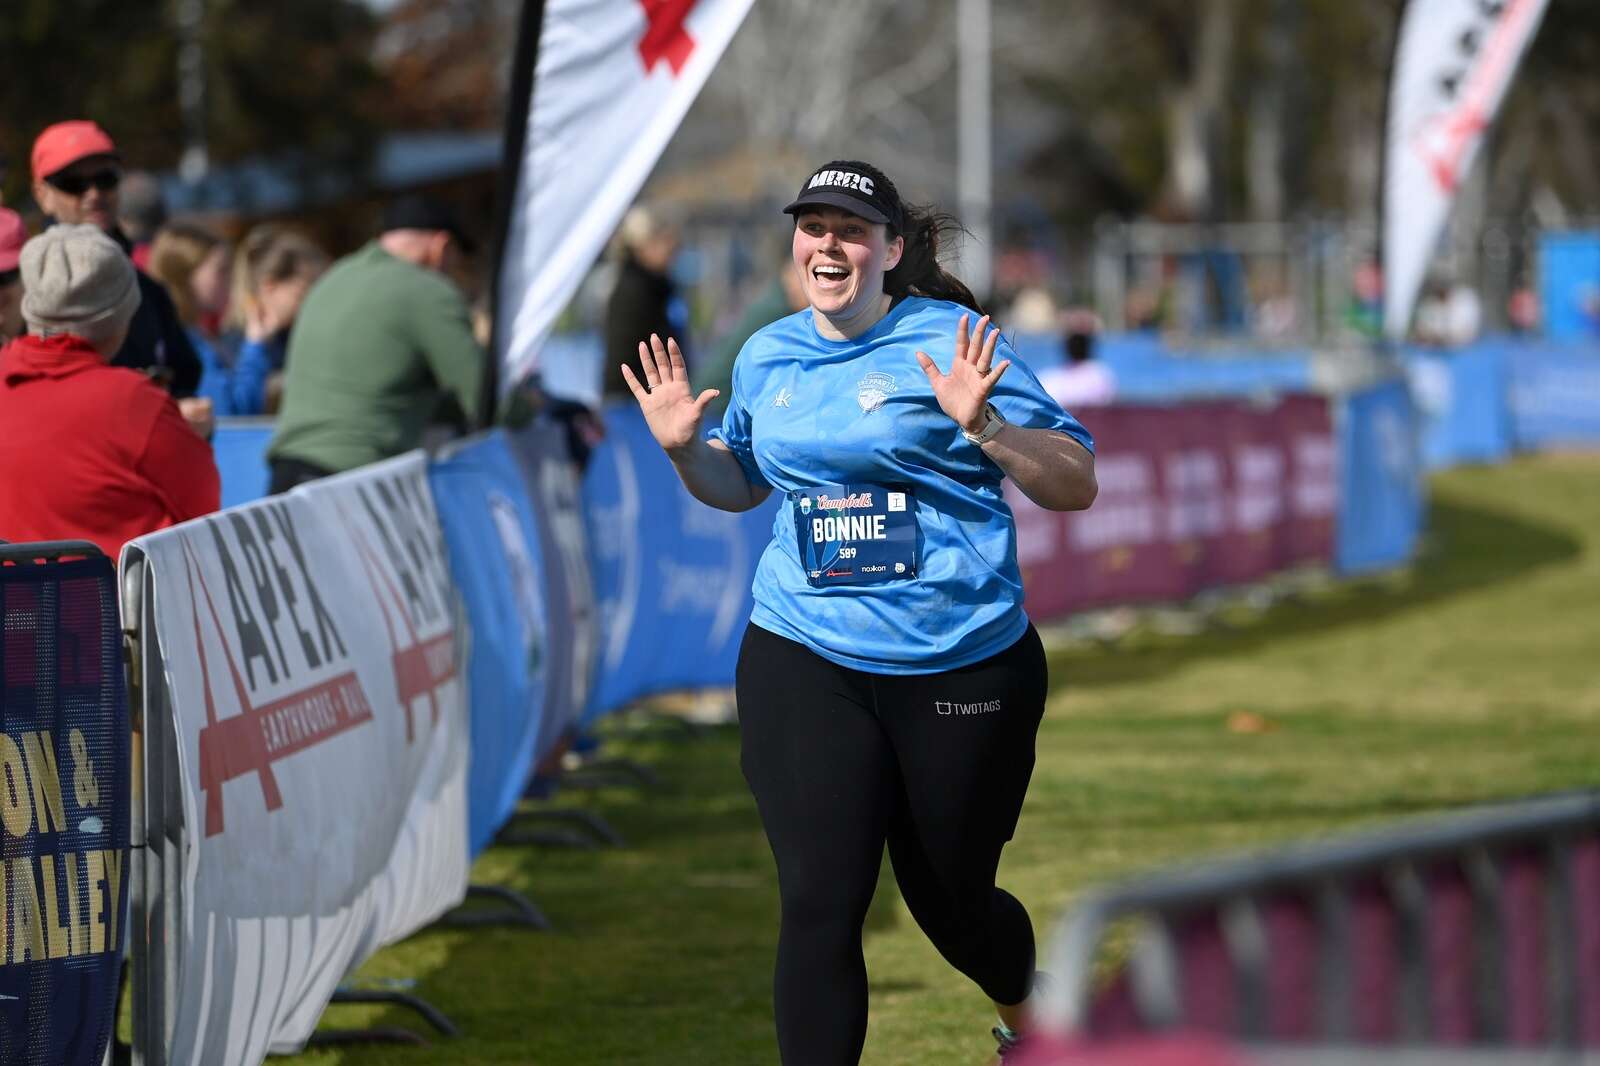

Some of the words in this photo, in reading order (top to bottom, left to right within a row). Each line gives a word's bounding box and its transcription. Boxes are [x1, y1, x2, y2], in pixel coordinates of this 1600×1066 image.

[807, 170, 875, 196] MRRC
[812, 514, 887, 543] BONNIE
[839, 547, 857, 560] 589
[207, 502, 347, 691] APEX
[953, 699, 1001, 715] TWOTAGS
[68, 728, 100, 808] &
[0, 848, 123, 966] ALLEY
